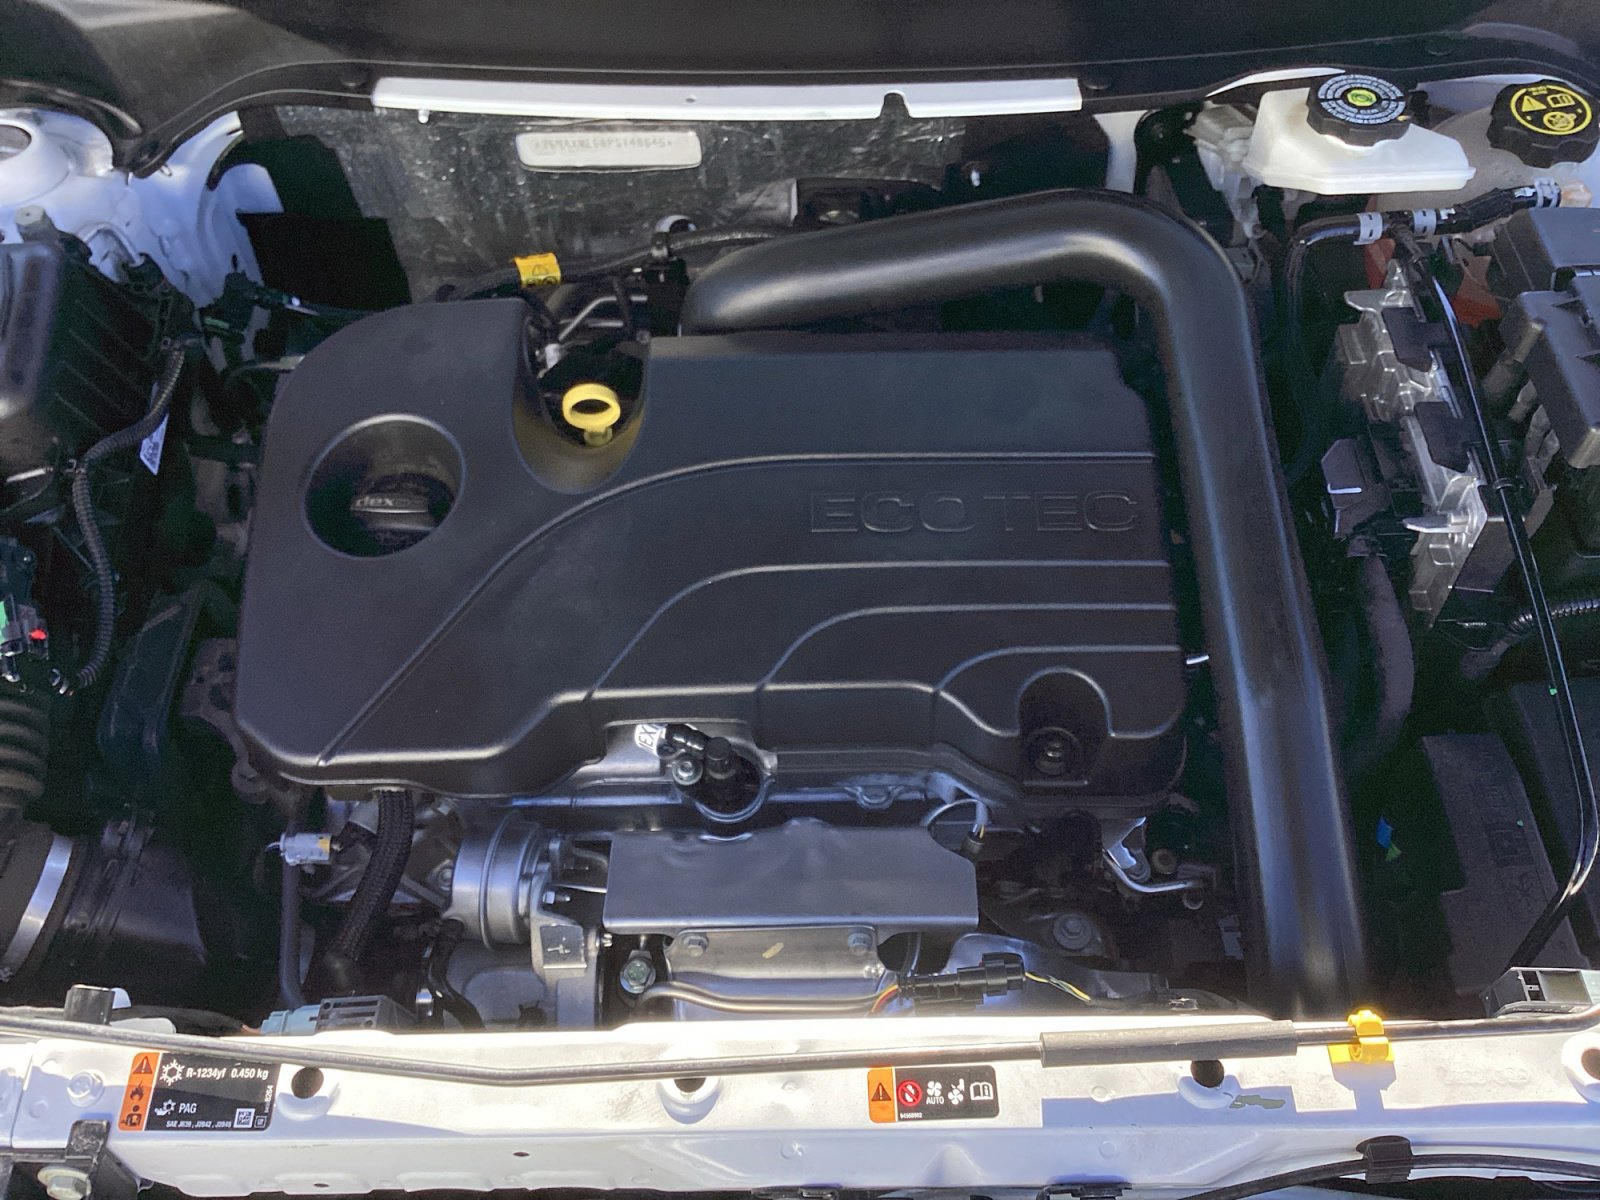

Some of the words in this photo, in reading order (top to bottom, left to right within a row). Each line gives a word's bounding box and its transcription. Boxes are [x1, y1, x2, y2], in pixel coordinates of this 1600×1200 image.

[811, 490, 1138, 532] ECOTEC
[186, 1066, 227, 1081] R-1234yf
[231, 1067, 256, 1079] 0.450
[256, 1068, 269, 1081] kg
[926, 1096, 945, 1105] AUTO
[178, 1103, 197, 1113] PAG
